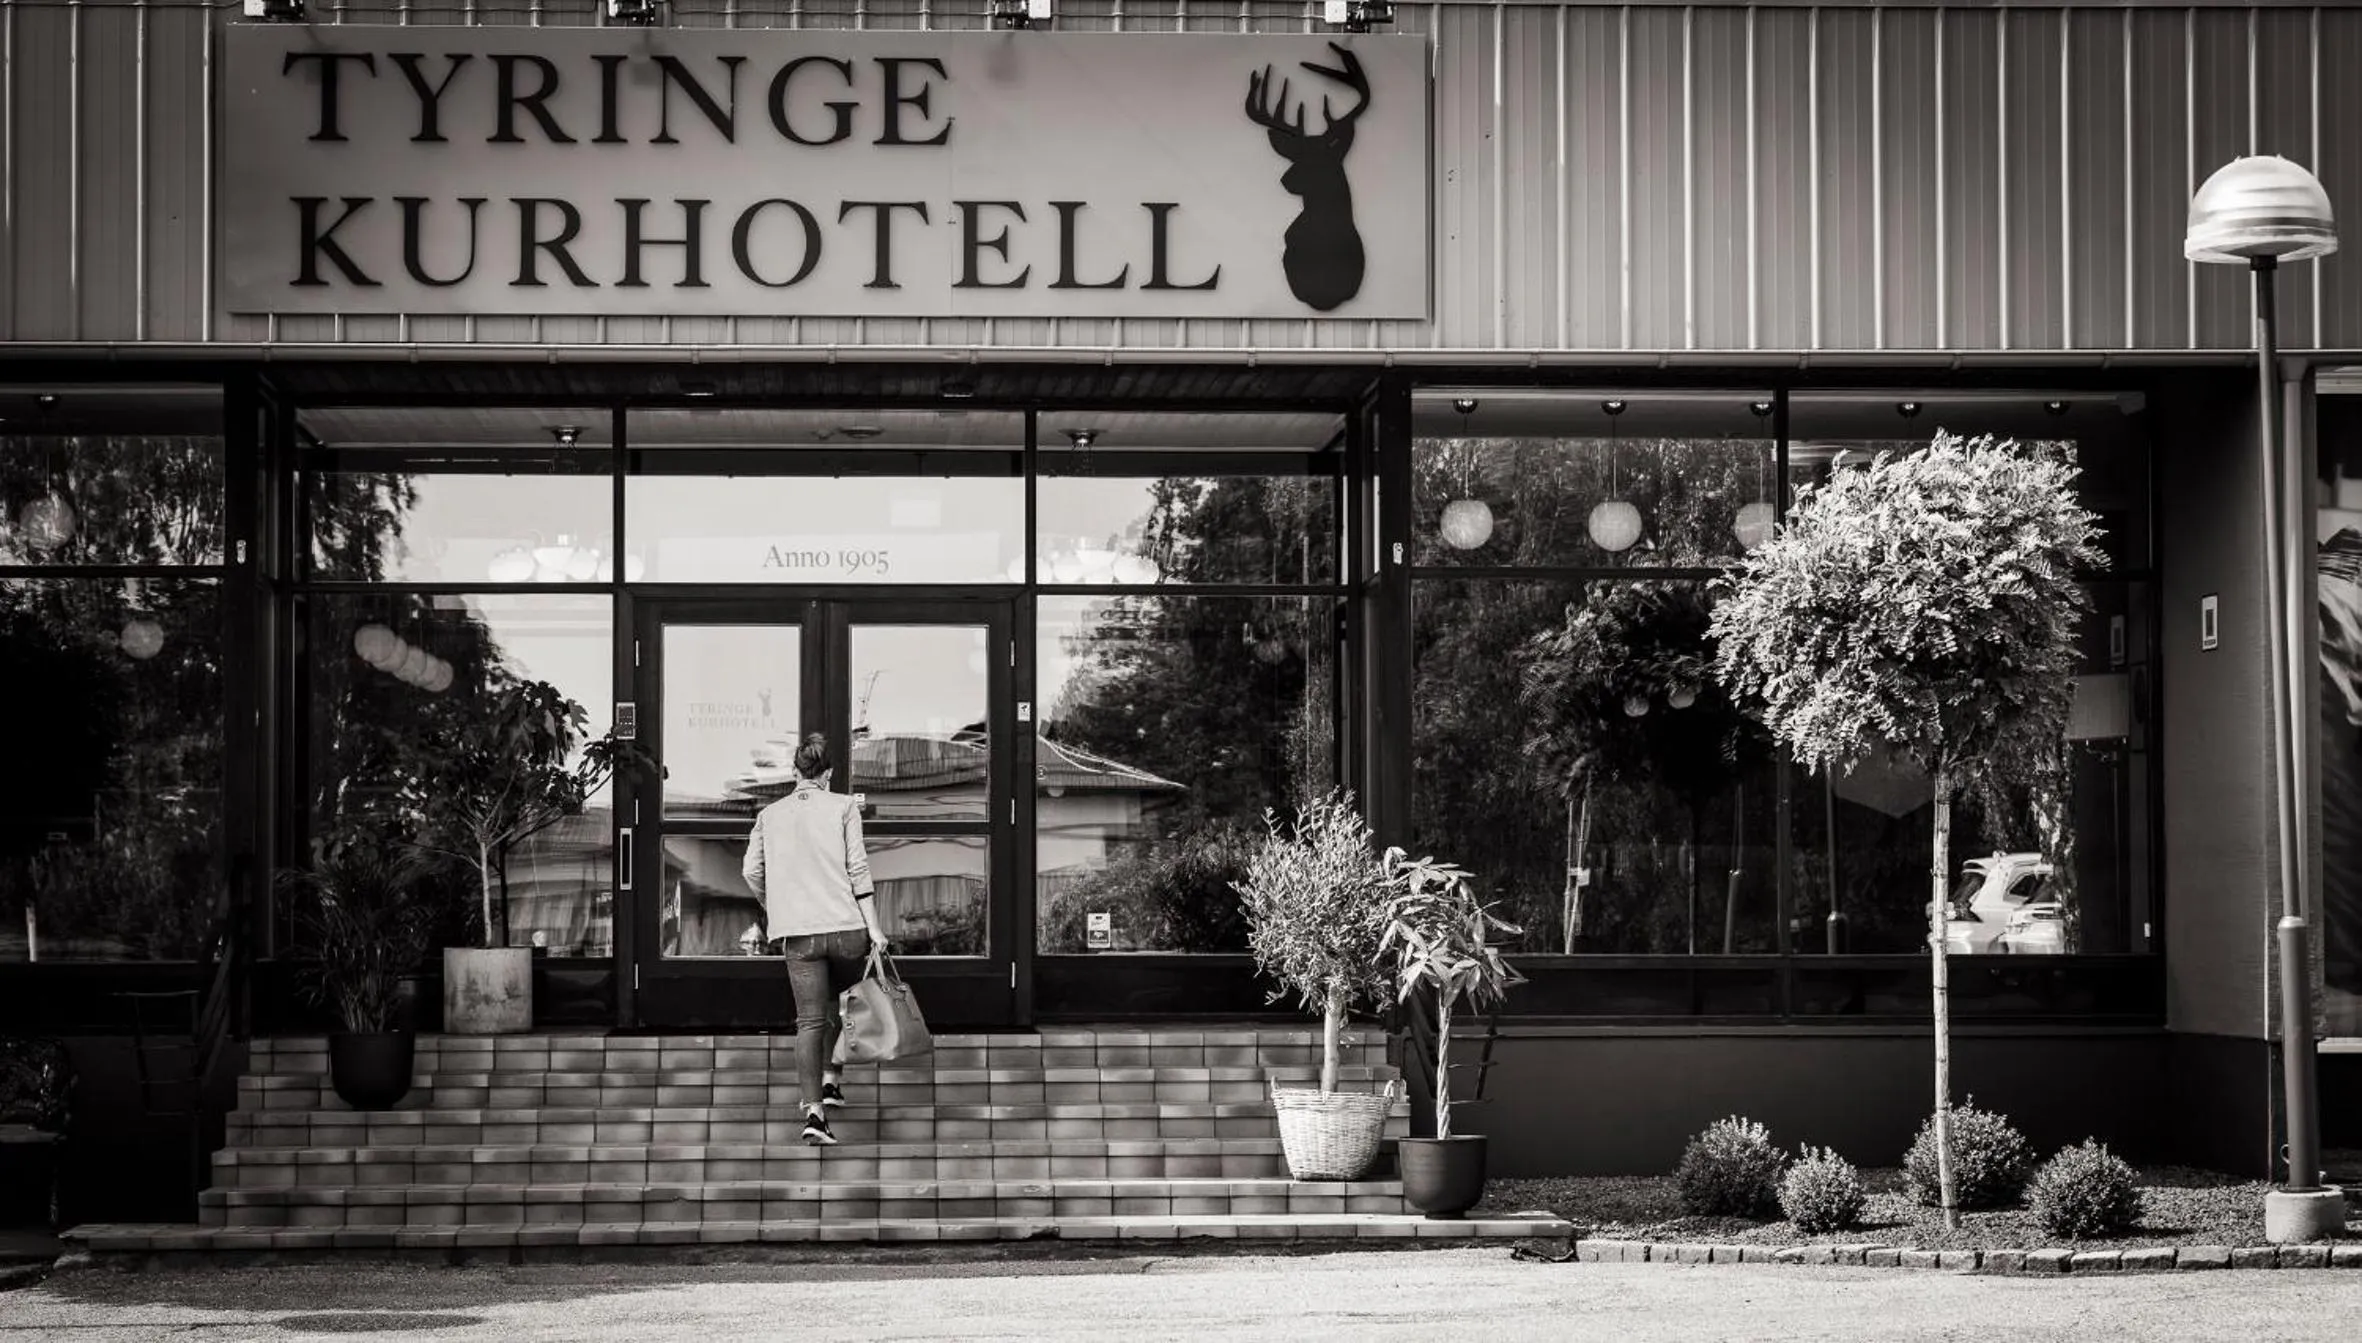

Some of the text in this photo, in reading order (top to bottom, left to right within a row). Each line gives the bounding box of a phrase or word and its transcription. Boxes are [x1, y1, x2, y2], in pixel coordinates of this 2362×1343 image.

[281, 51, 953, 147] TYRINGE
[288, 196, 1221, 291] KURHOTELL
[762, 544, 889, 575] Anno 1905
